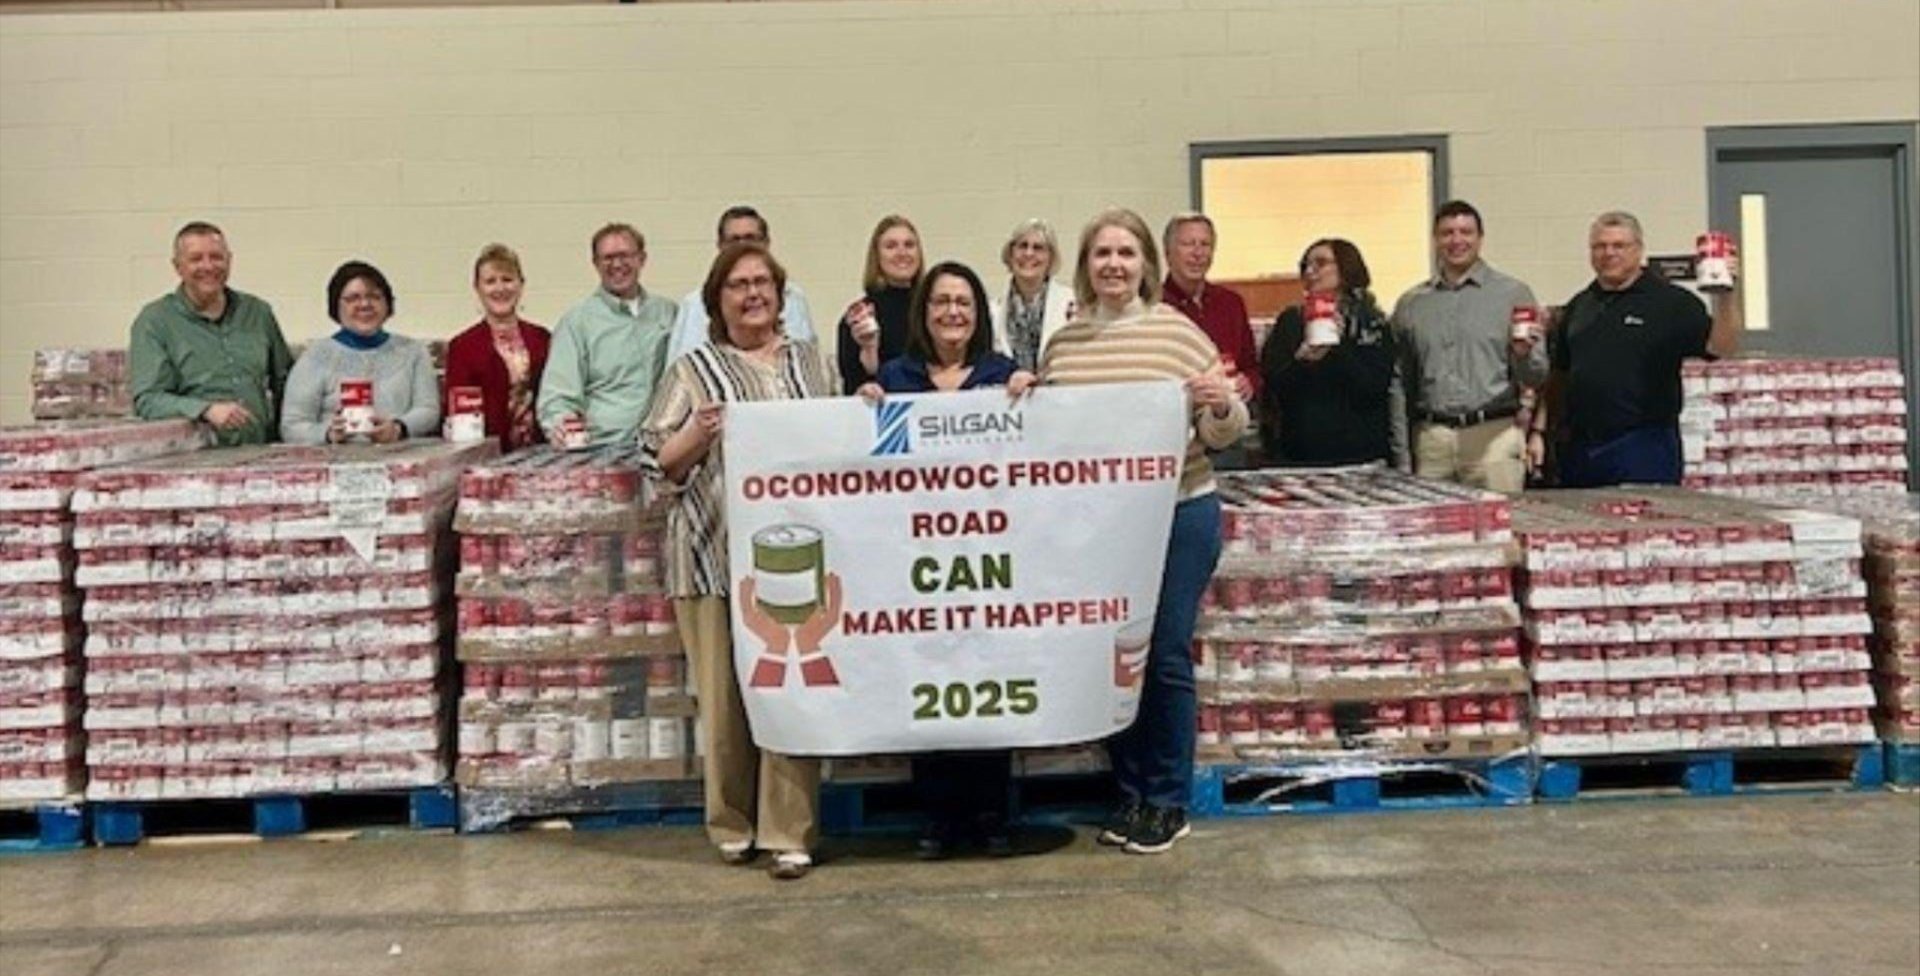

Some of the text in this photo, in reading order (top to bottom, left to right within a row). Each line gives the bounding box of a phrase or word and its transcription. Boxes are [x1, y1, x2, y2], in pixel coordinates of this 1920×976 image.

[743, 455, 1177, 500] OCONOMOWOC FRONTIER
[912, 510, 1009, 538] ROAD
[910, 554, 1013, 594] CAN
[842, 597, 1129, 637] MAKE IT HAPPEN!
[912, 679, 1039, 721] 2025
